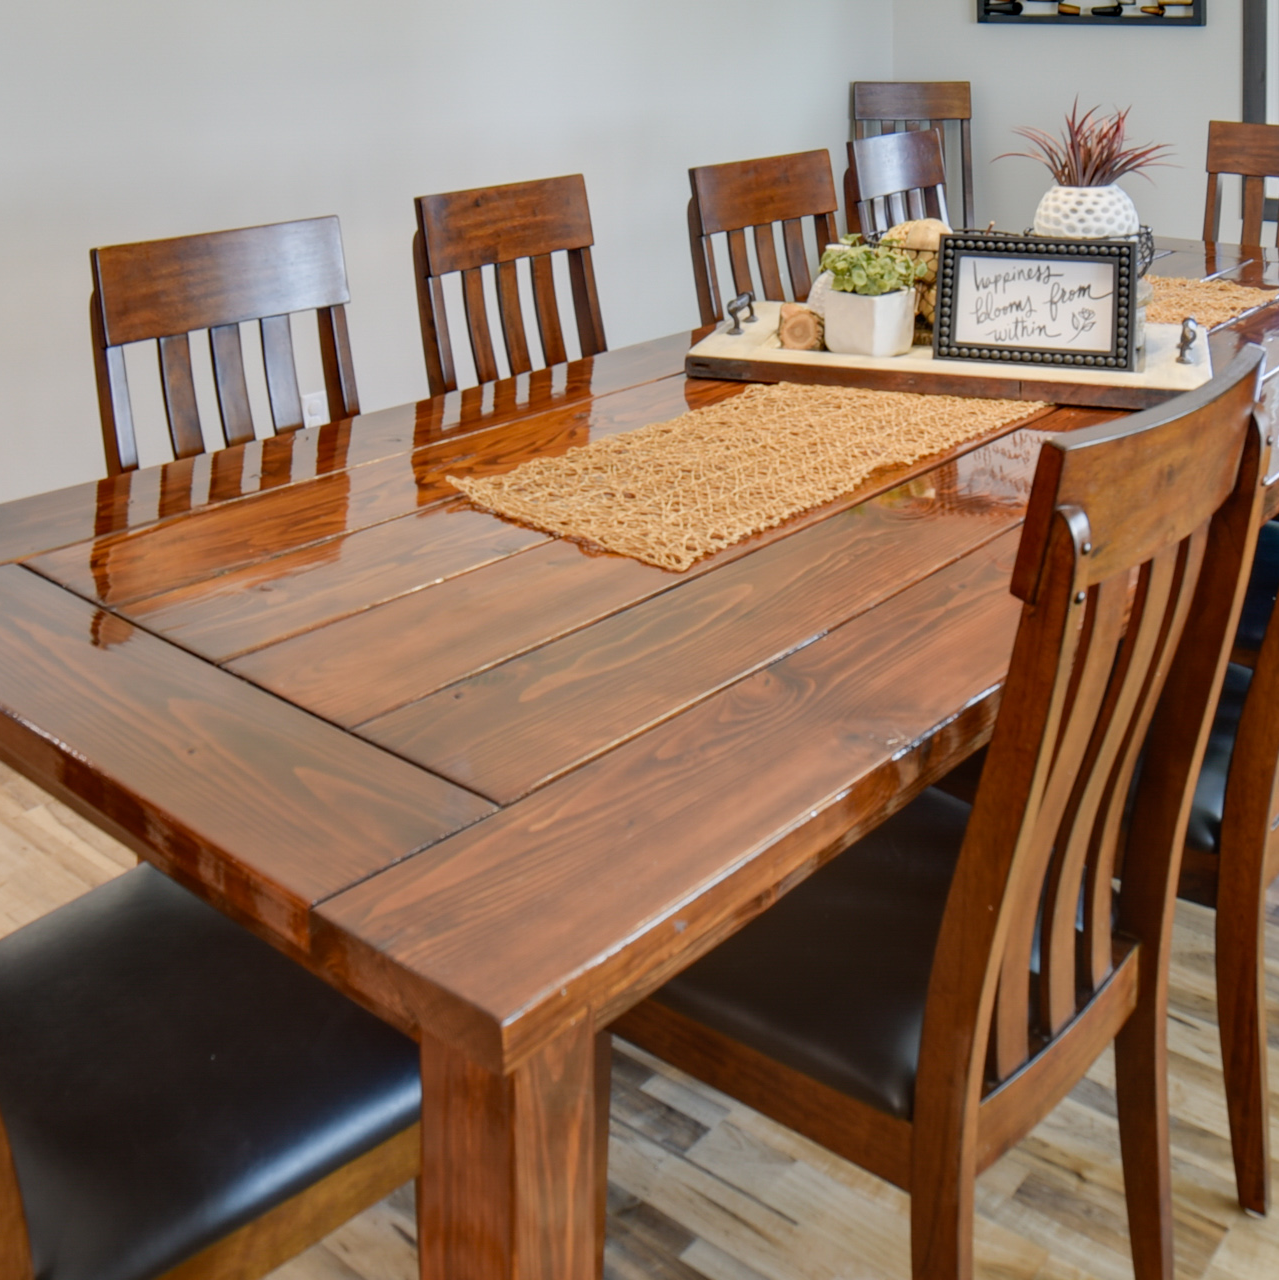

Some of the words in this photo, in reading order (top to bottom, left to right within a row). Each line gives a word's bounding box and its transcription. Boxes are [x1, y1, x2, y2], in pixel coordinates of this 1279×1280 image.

[973, 260, 1064, 294] happiness
[969, 292, 1037, 325] blooms
[1043, 282, 1113, 322] from
[985, 317, 1062, 342] within
